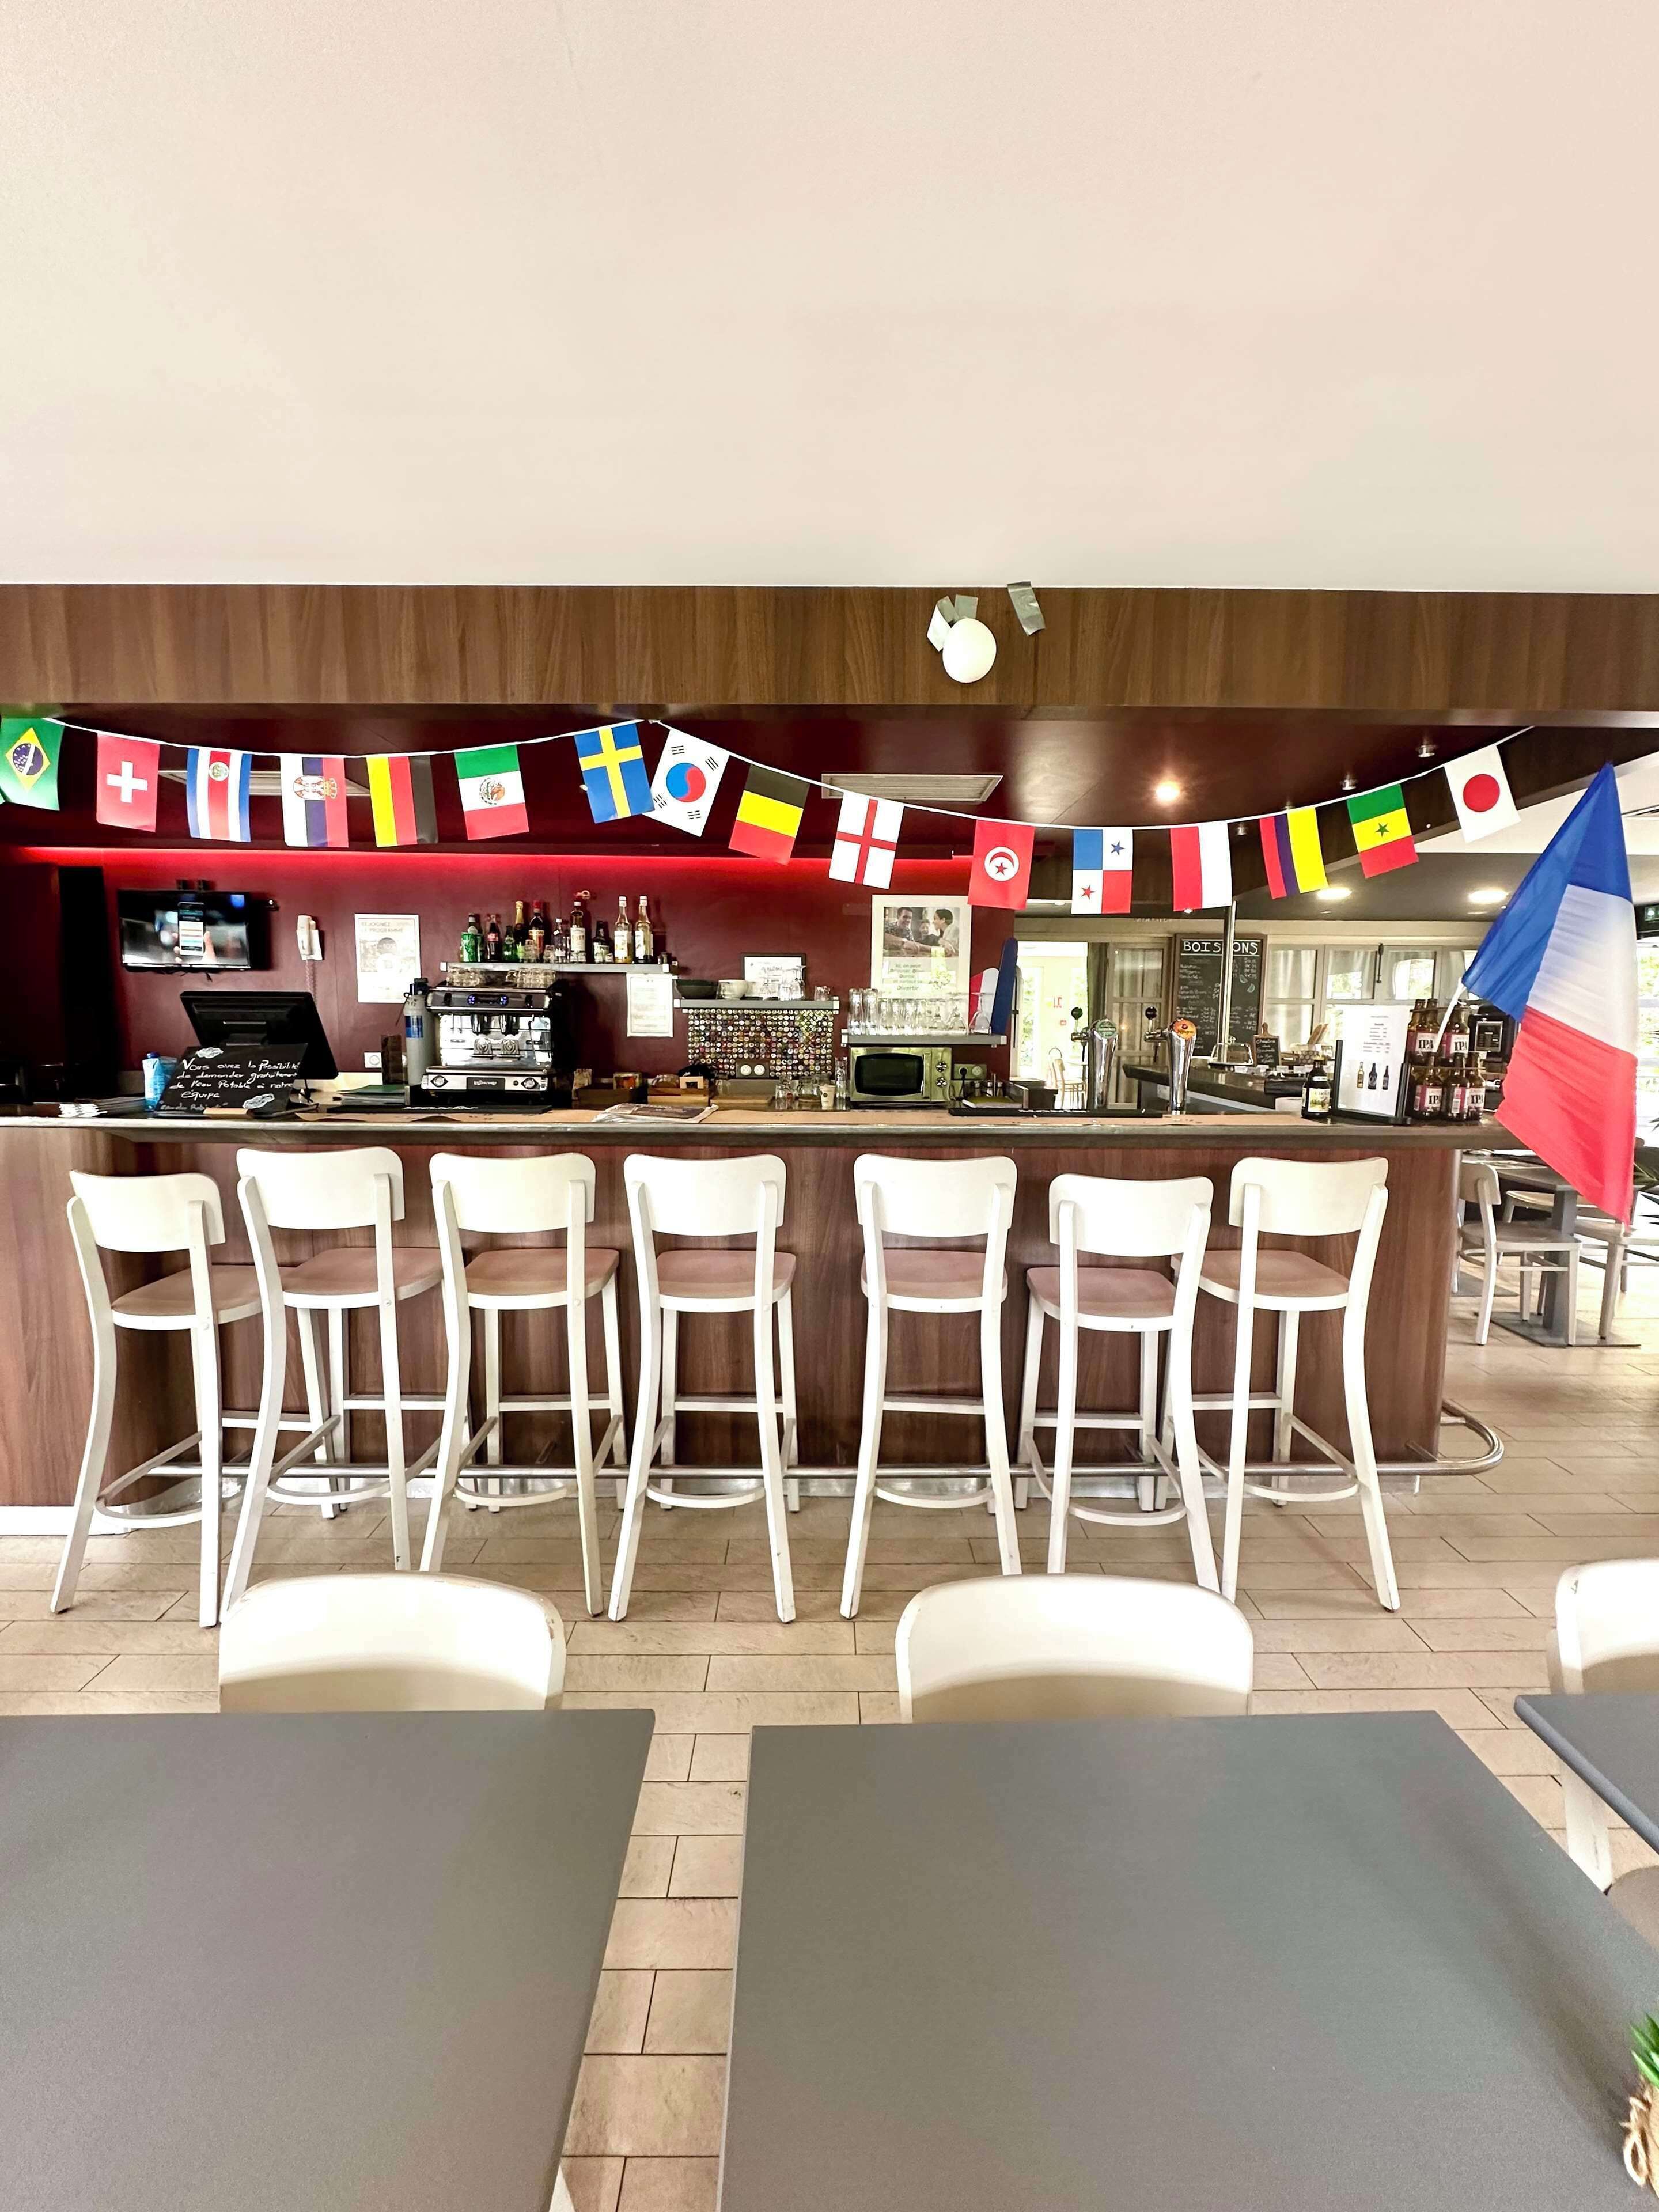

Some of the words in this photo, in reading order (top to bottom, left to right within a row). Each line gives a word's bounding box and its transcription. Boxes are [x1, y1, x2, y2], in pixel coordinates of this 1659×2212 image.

[1184, 941, 1258, 955] BOISONS
[1418, 1039, 1434, 1049] IPA
[182, 1058, 210, 1071] Vous
[248, 1060, 257, 1069] la
[181, 1089, 220, 1101] équipe
